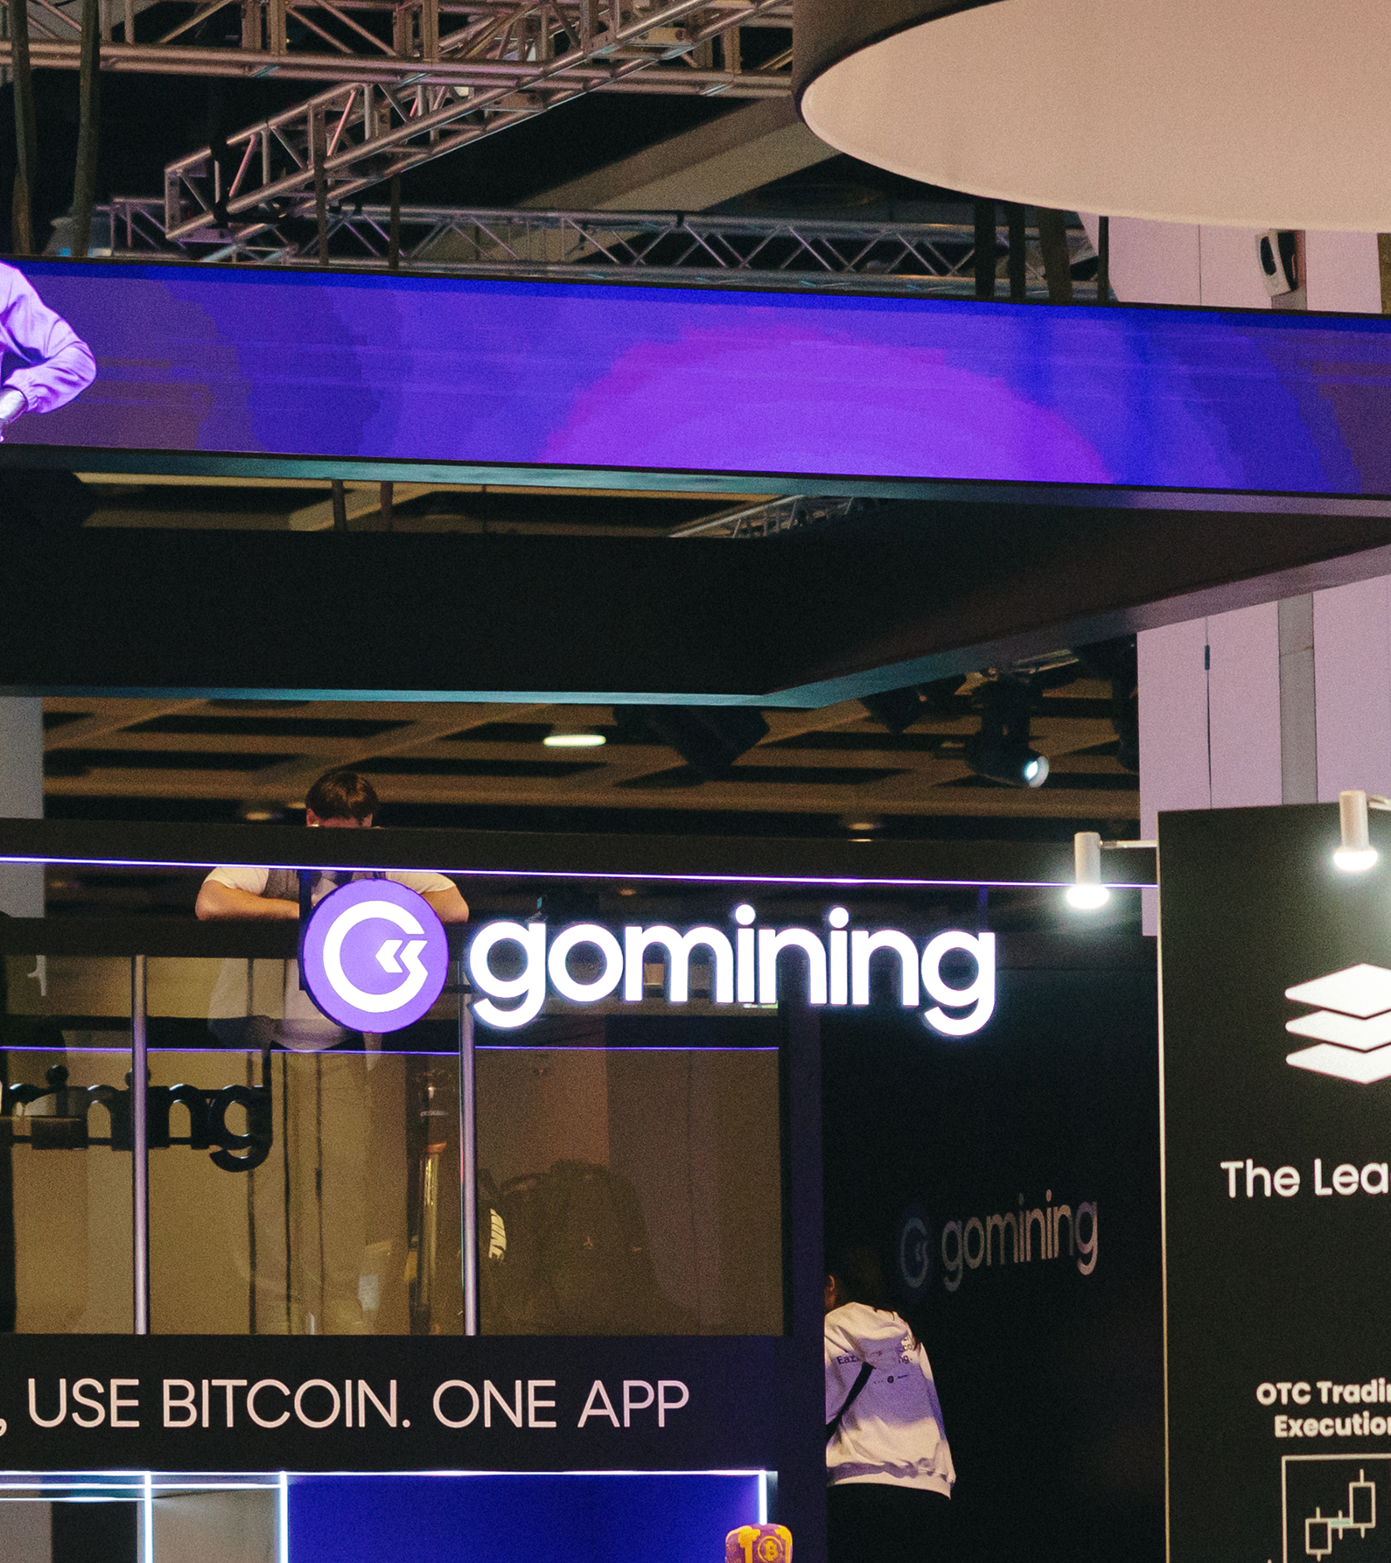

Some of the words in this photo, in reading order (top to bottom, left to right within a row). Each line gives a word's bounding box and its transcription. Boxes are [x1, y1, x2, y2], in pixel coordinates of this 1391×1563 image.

[467, 904, 998, 1037] gomining
[1220, 1159, 1301, 1198] The
[1314, 1158, 1391, 1197] Lea
[941, 1188, 1099, 1292] gomining
[27, 1378, 140, 1429] USE
[162, 1379, 412, 1429] BITCOIN.
[432, 1379, 557, 1430] ONE
[577, 1379, 690, 1430] APP
[1255, 1381, 1312, 1406] OTC
[1316, 1378, 1391, 1405] Tradi
[1274, 1411, 1391, 1438] Executio
